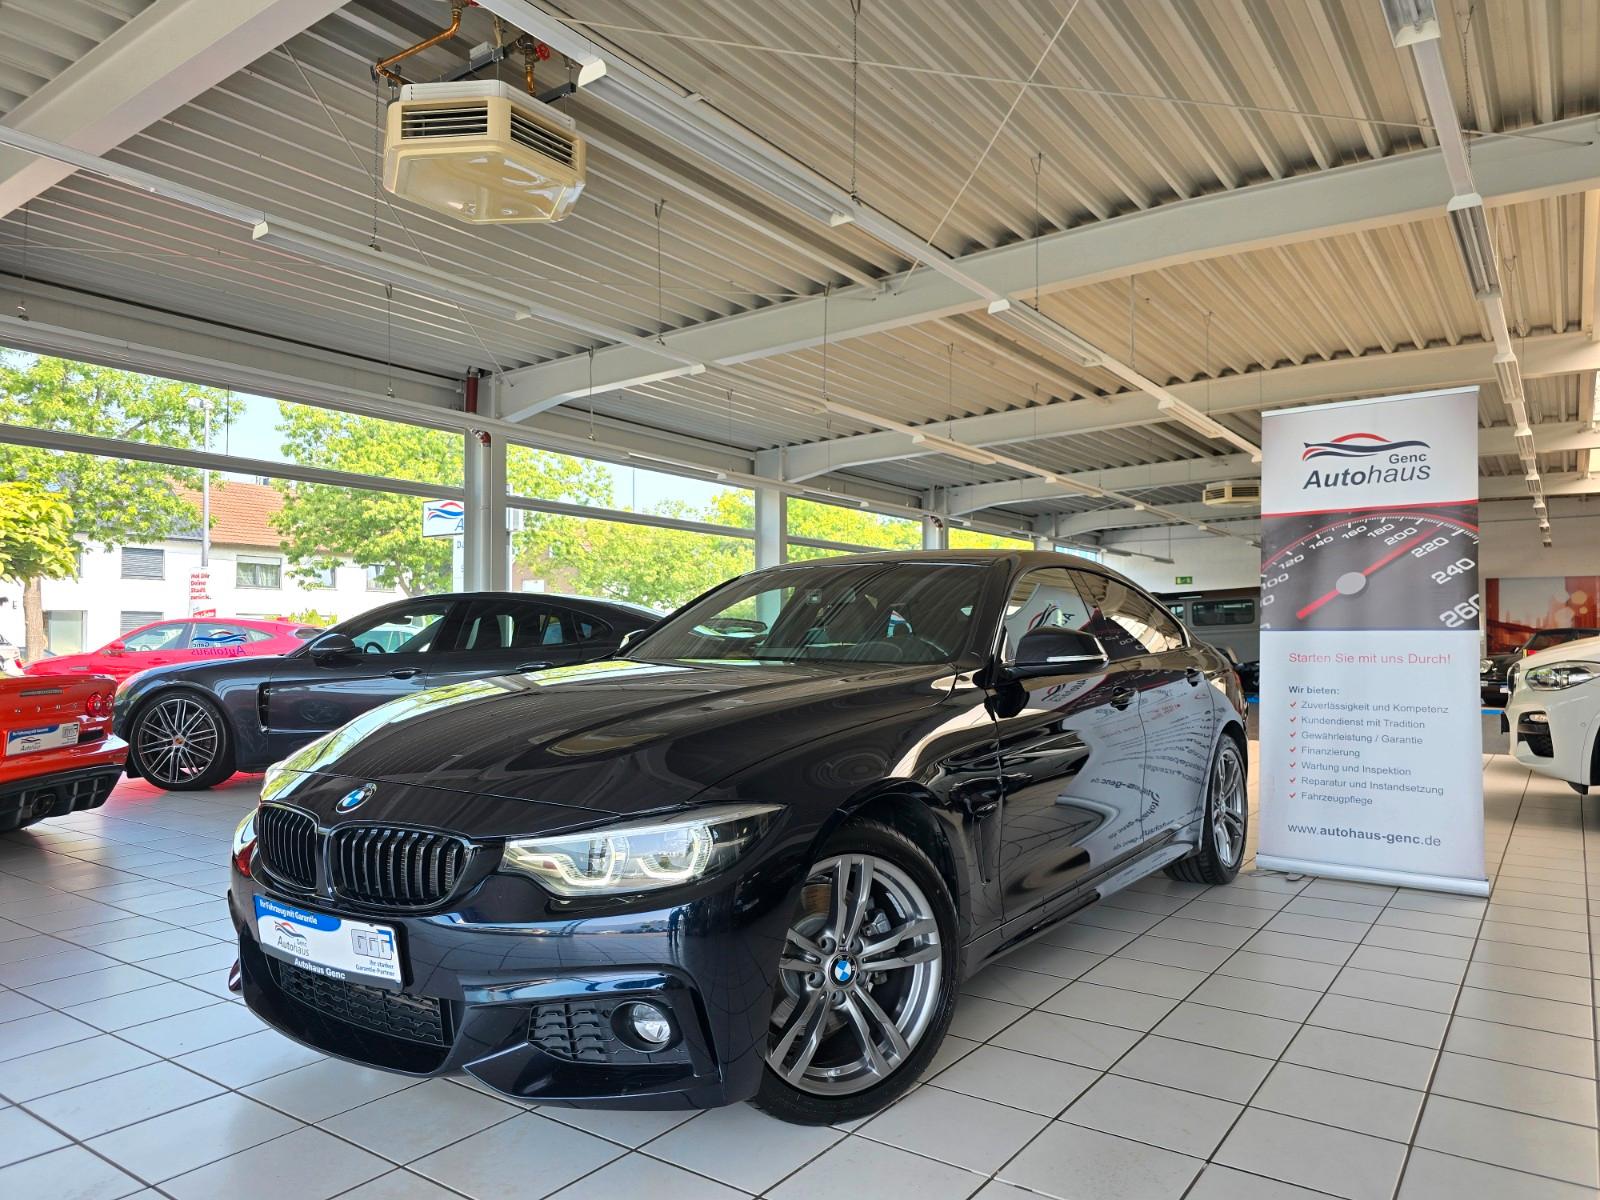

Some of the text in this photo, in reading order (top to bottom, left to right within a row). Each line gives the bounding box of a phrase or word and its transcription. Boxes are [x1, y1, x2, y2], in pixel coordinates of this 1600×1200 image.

[1389, 453, 1427, 464] Genc
[1302, 465, 1431, 490] Autohaus
[1341, 525, 1367, 539] 160
[1367, 523, 1395, 538] 180
[1384, 527, 1418, 546] 200
[1309, 536, 1334, 550] 140
[1411, 537, 1449, 558] 220
[1278, 554, 1304, 569] 120
[1431, 558, 1476, 585] 240
[1261, 573, 1289, 590] 100
[1289, 652, 1451, 664] Starten Sie mit uns Durch!
[1289, 685, 1340, 695] Wir bieten:
[1300, 700, 1448, 714] Zuverlässigkeit und Kompetenz
[1301, 716, 1425, 729] Kundendienst mit Tradition
[1301, 731, 1372, 743] Gewährleistung
[1381, 734, 1423, 745] Garantie
[1301, 746, 1360, 758] Finanzierung
[1301, 761, 1411, 776] Wartung und Inspektion
[1301, 777, 1444, 796] Reparatur und Instandsetzung
[1301, 791, 1373, 806] Fahrzeugpflege
[1287, 824, 1442, 847] www.autohaus-genc.de
[277, 935, 310, 957] Autohaus
[294, 958, 346, 980] Autohaus Genc
